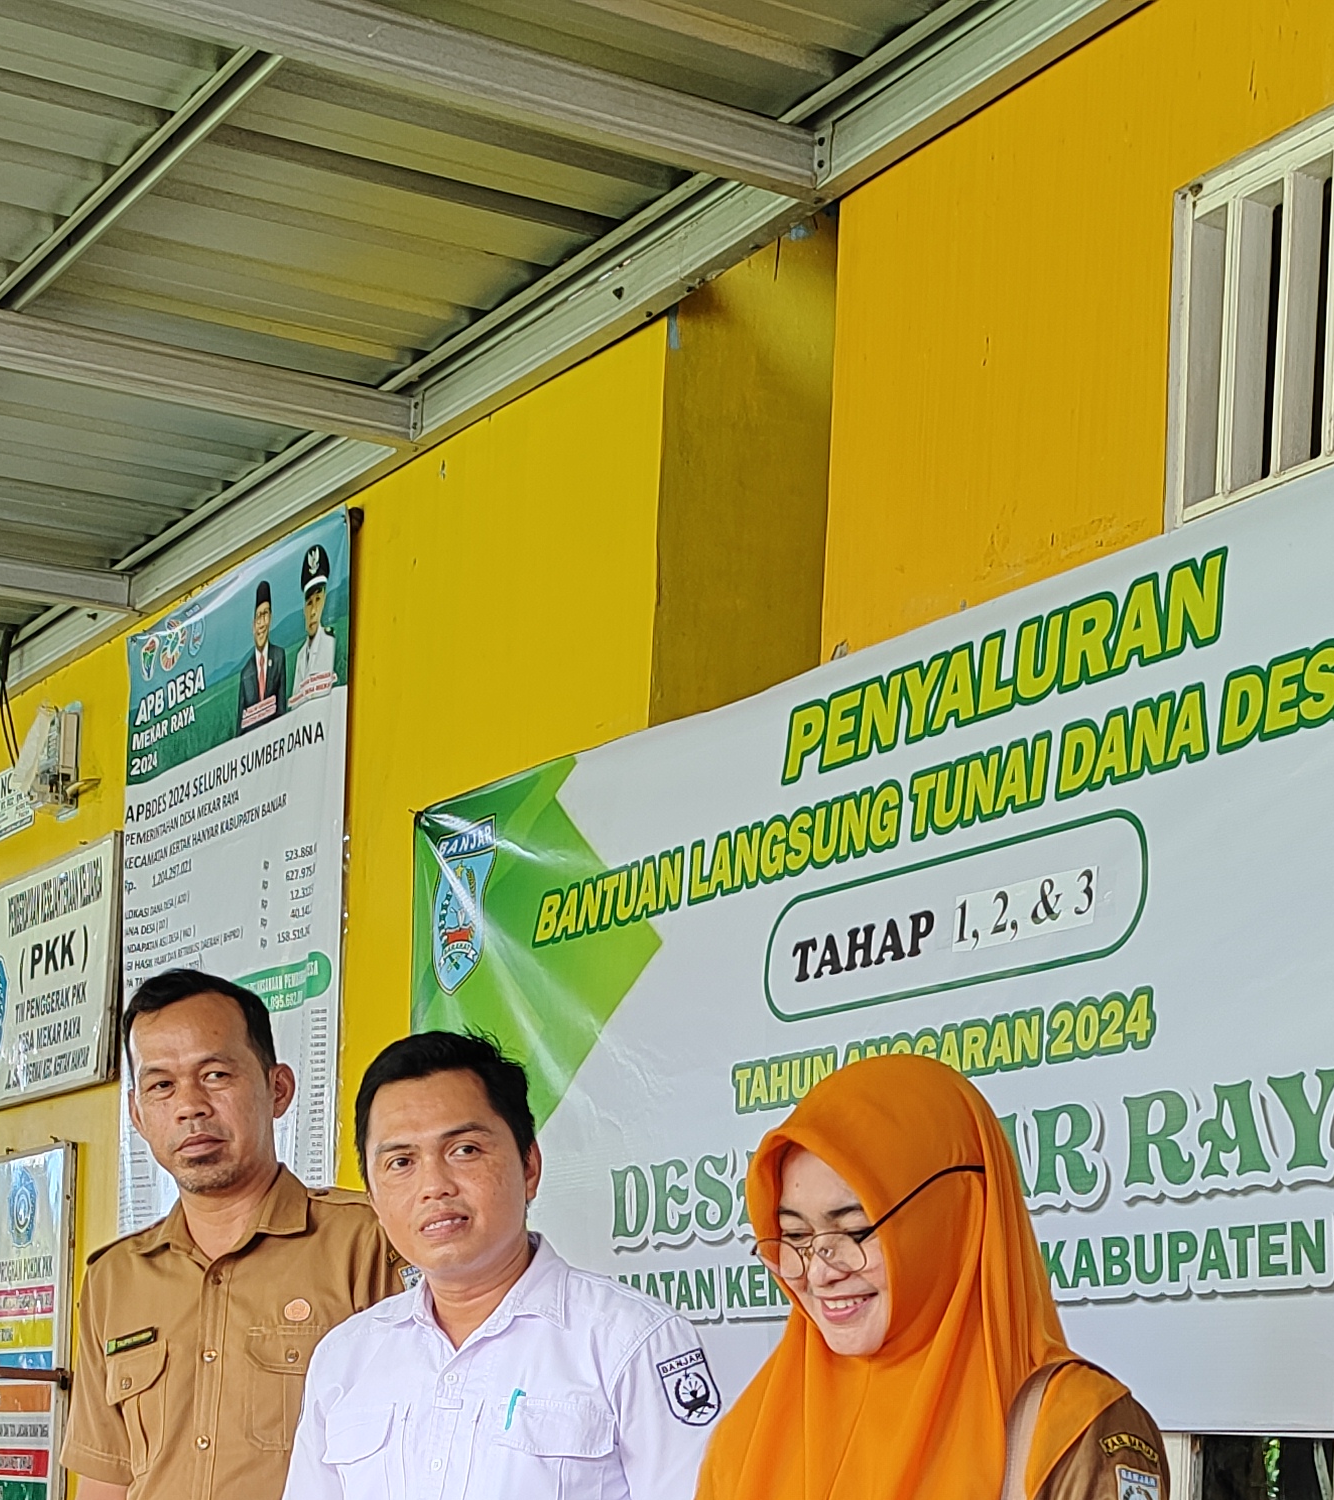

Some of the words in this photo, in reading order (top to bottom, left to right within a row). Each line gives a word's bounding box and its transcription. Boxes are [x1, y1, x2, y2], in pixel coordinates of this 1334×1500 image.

[782, 547, 1228, 786] PENYALURAN
[135, 687, 165, 727] APB
[167, 664, 206, 706] DESA
[132, 721, 169, 752] MEKAR
[170, 705, 196, 733] RAYA
[125, 795, 166, 824] APBDES
[168, 785, 190, 809] 2024
[192, 763, 238, 797] SELURUH
[241, 737, 285, 777] SUMBER
[287, 721, 325, 755] DANA
[130, 751, 158, 776] 2024
[222, 788, 240, 809] RAYA
[532, 848, 685, 949] BANTUAN
[688, 780, 901, 906] LANGSUNG
[909, 730, 1052, 842] TUNAI
[1058, 682, 1208, 800] DANA
[124, 847, 168, 870] KECAMATAN
[438, 824, 494, 855] BANJAR
[791, 909, 934, 985] TAHAP
[954, 900, 981, 950] 1,
[989, 889, 1019, 942] 2,
[1030, 877, 1064, 924] &
[1073, 868, 1096, 918] 3
[30, 928, 77, 980] PKK
[71, 980, 87, 1007] PKK
[36, 1020, 62, 1050] MEKAR
[63, 1015, 81, 1042] RAYA
[1049, 985, 1154, 1063] 2024
[1040, 1218, 1326, 1290] KABUPATEN
[661, 1351, 703, 1375] BANJAR
